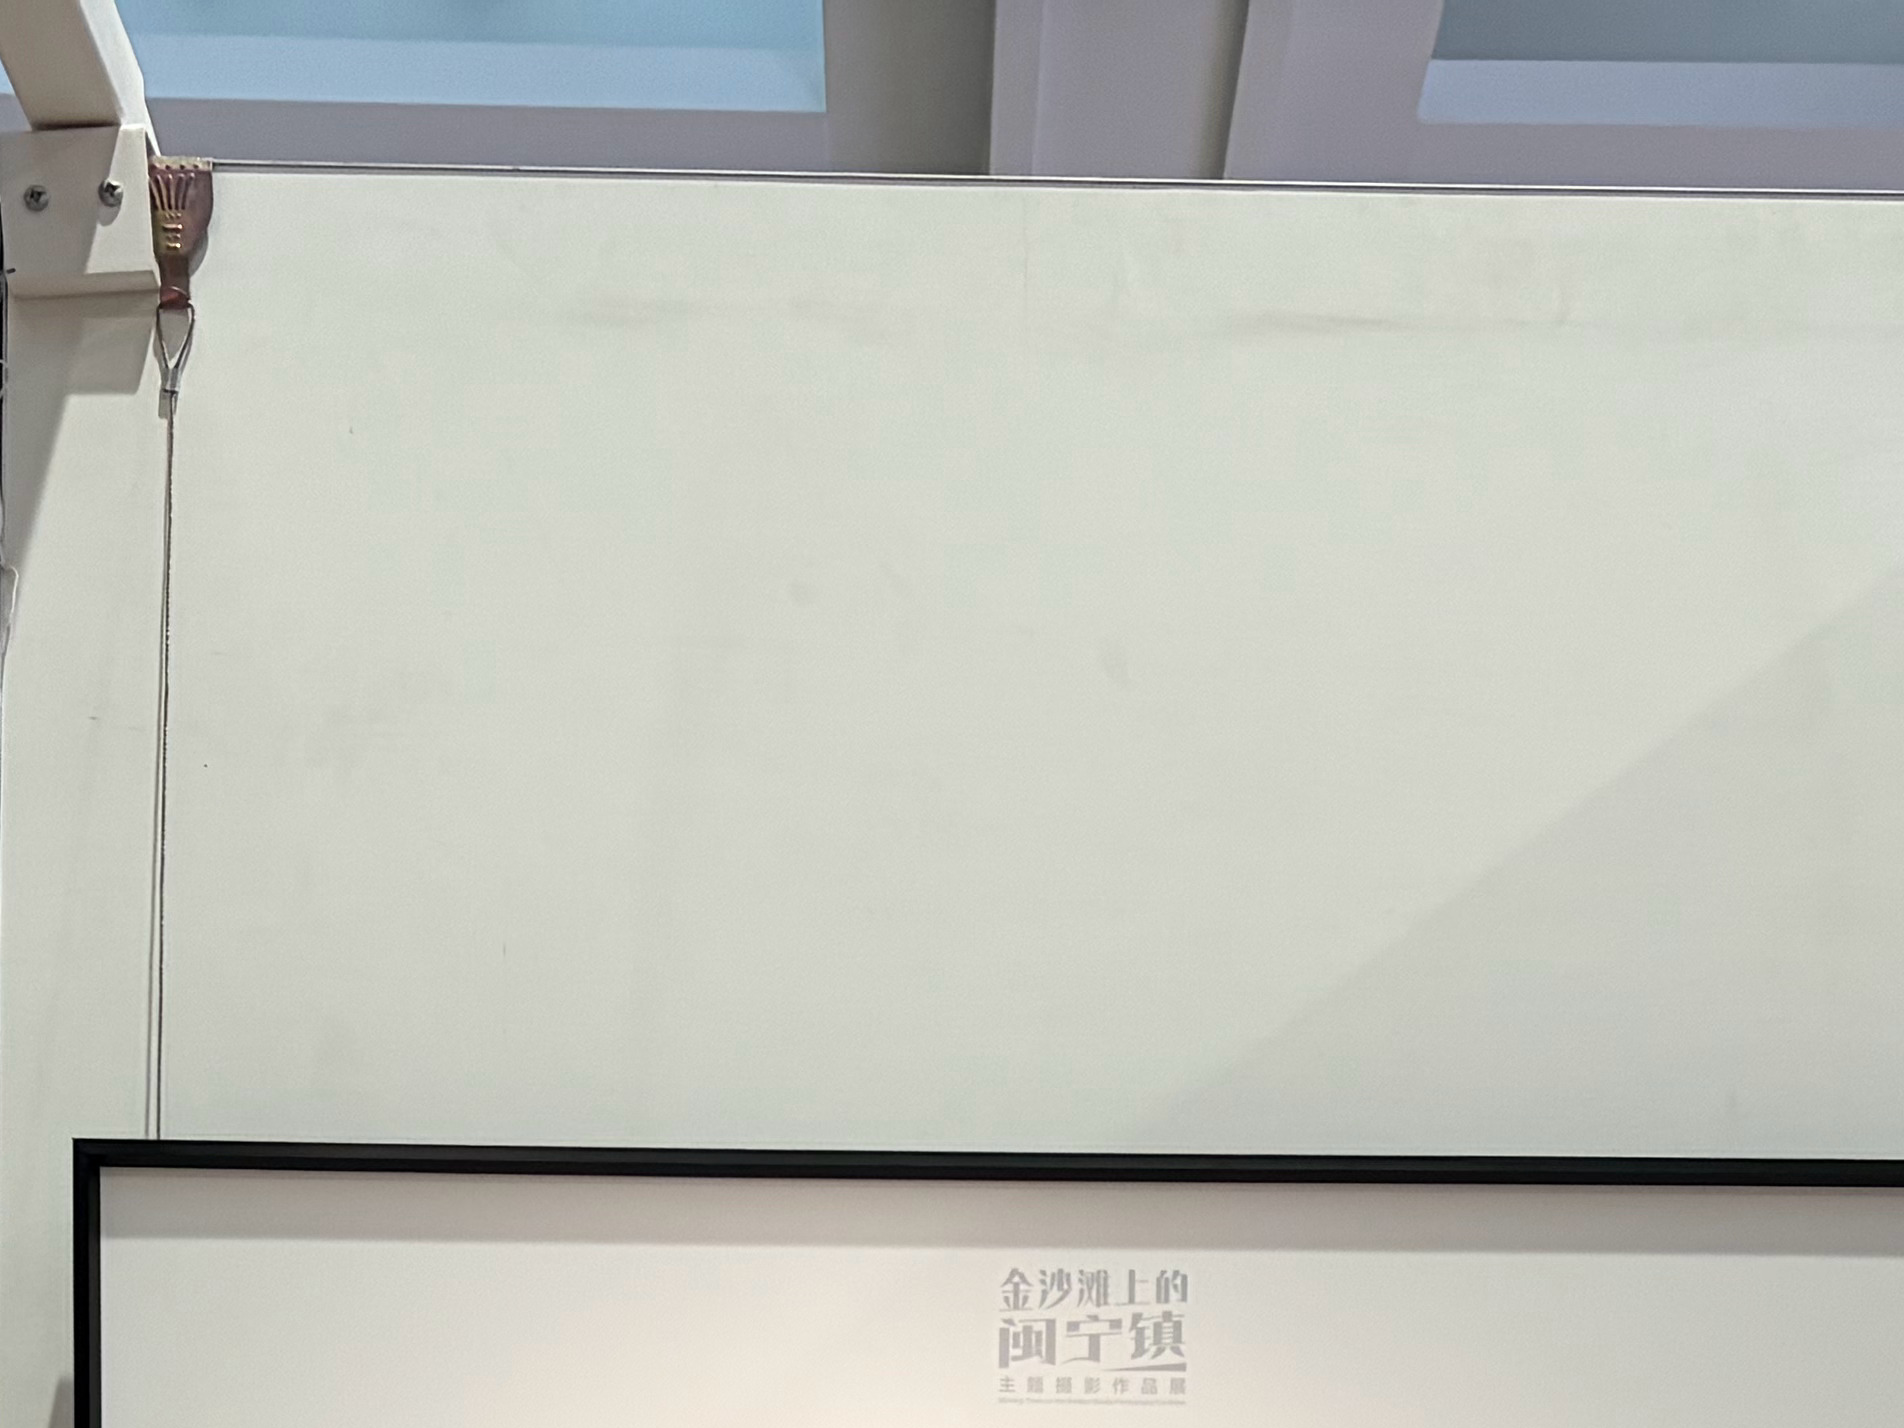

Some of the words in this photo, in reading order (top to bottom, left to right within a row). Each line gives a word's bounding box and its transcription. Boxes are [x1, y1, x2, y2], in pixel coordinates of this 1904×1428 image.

[1000, 1268, 1188, 1311] 金沙滩上的
[999, 1310, 1186, 1368] 闽宁镇
